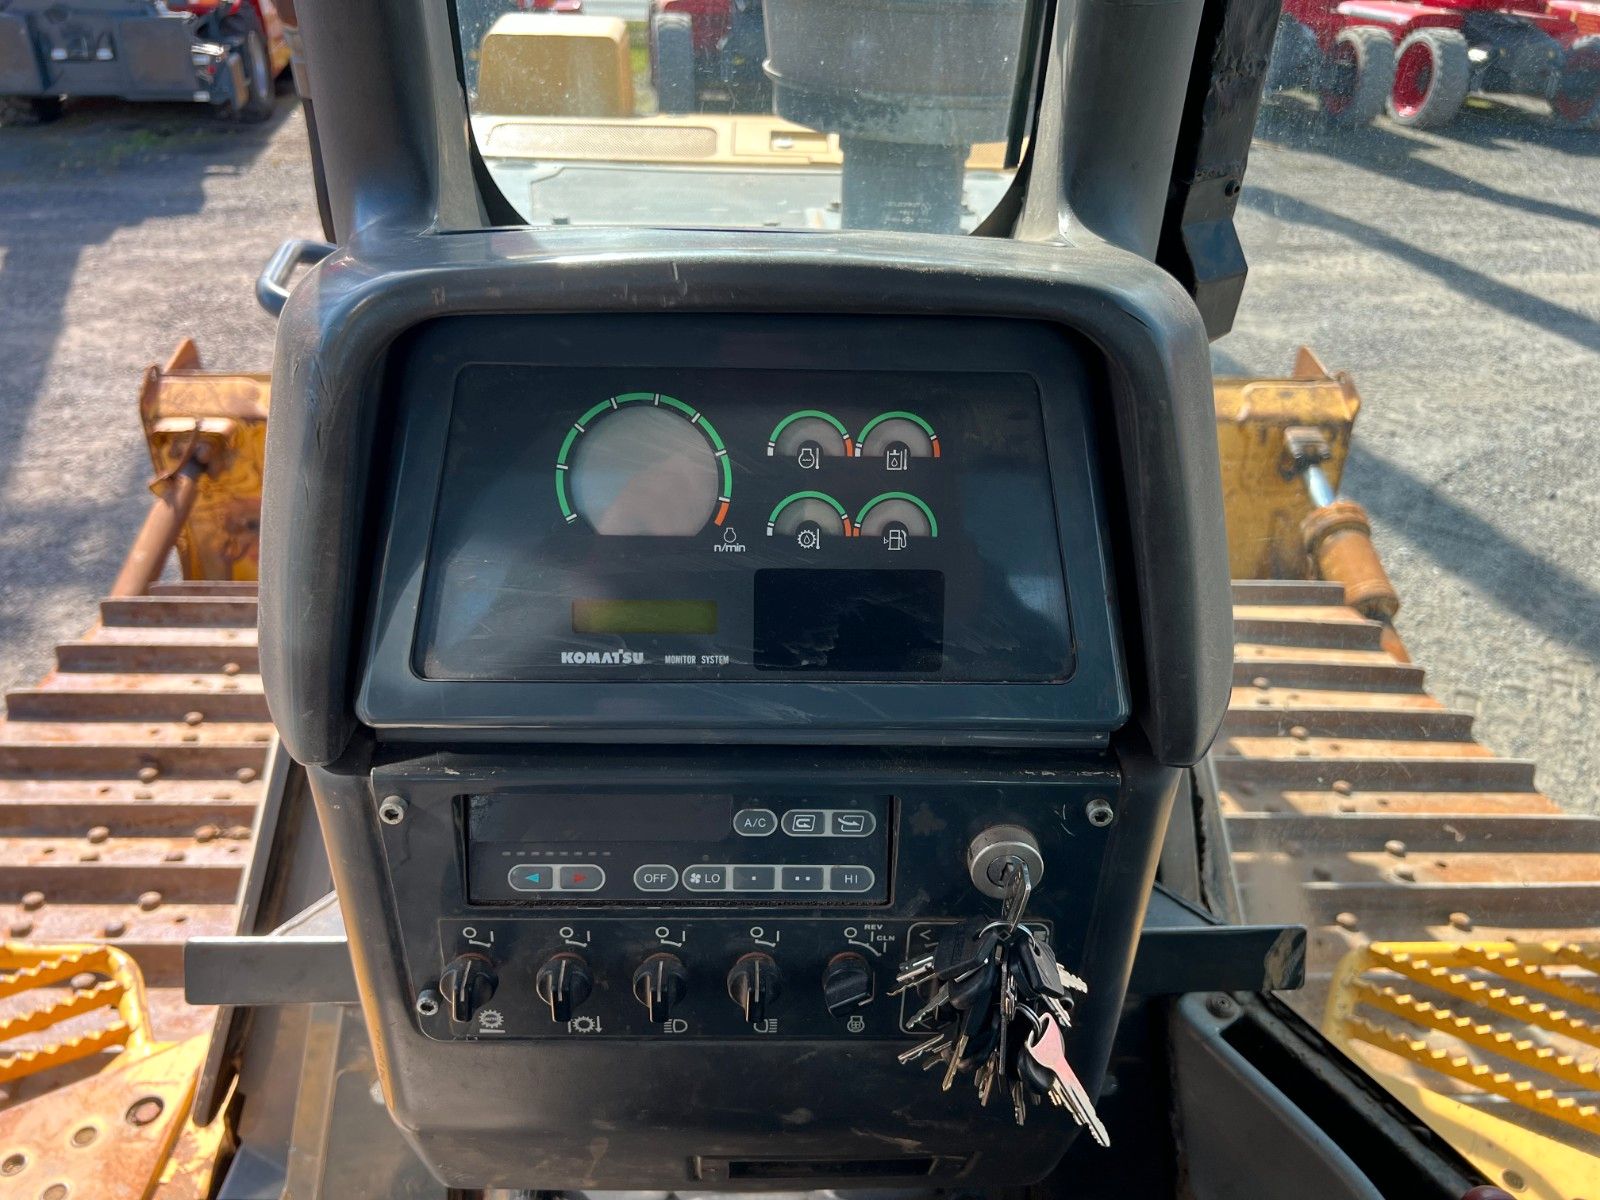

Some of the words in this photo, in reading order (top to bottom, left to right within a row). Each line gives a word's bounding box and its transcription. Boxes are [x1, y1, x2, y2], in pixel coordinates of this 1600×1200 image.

[714, 543, 746, 552] n/min
[561, 649, 644, 664] KOMATSU
[665, 655, 696, 664] MONITOR
[701, 655, 730, 664] SYSTEM
[743, 817, 767, 828] A/C
[643, 873, 667, 883] OFF
[704, 873, 721, 884] LO
[844, 873, 859, 884] HI
